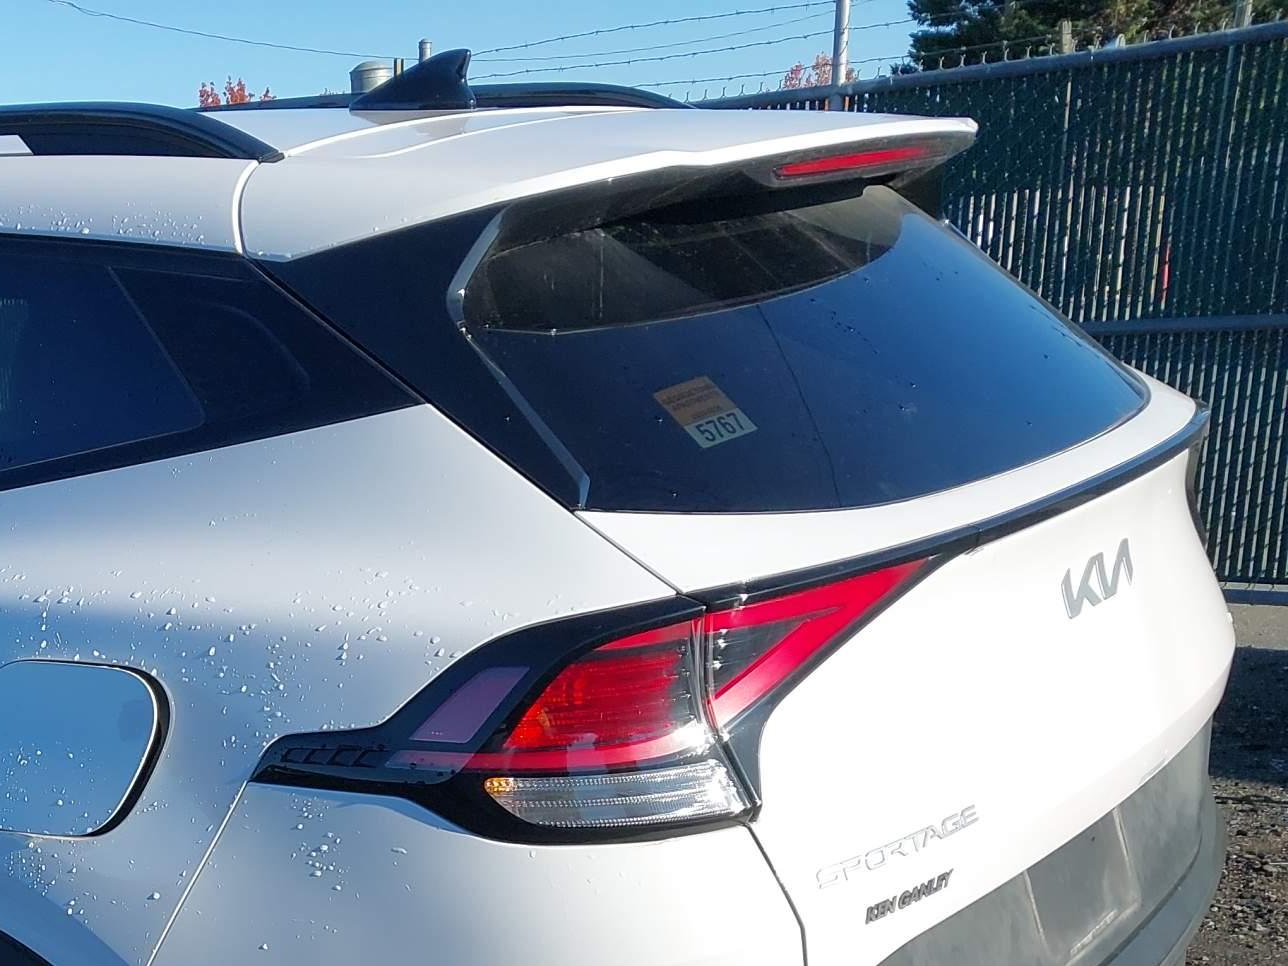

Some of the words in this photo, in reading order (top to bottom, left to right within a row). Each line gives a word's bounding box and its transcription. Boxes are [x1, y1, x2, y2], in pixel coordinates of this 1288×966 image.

[695, 412, 745, 442] 5767
[815, 804, 979, 890] SPORTAGE
[865, 896, 898, 925] KEN
[898, 868, 955, 910] GANLEY
